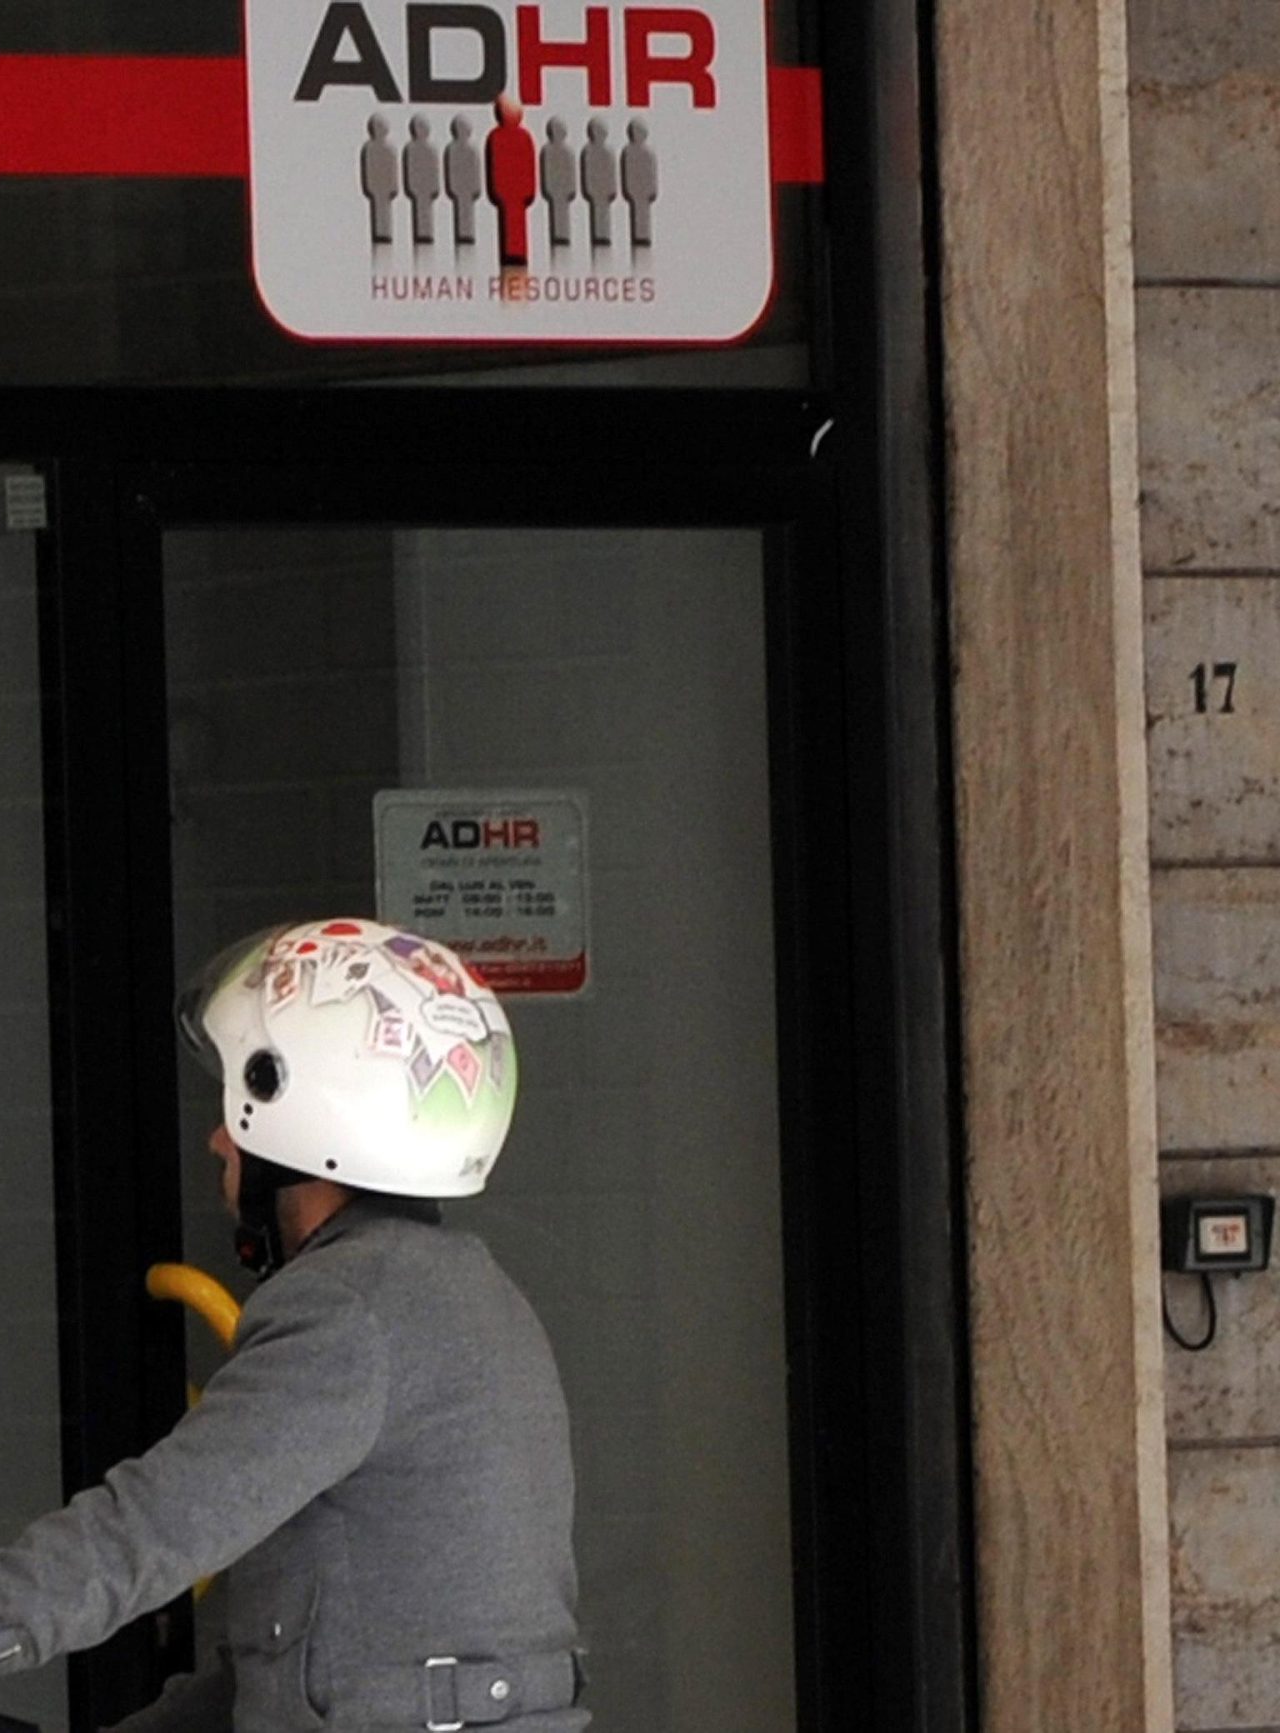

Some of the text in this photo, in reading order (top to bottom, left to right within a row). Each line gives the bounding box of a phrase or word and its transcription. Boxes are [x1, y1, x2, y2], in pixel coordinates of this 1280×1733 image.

[294, 1, 716, 108] ADHR
[372, 274, 656, 302] HUMAN RESOURCES
[1188, 662, 1238, 714] 17
[421, 819, 540, 849] ADHR
